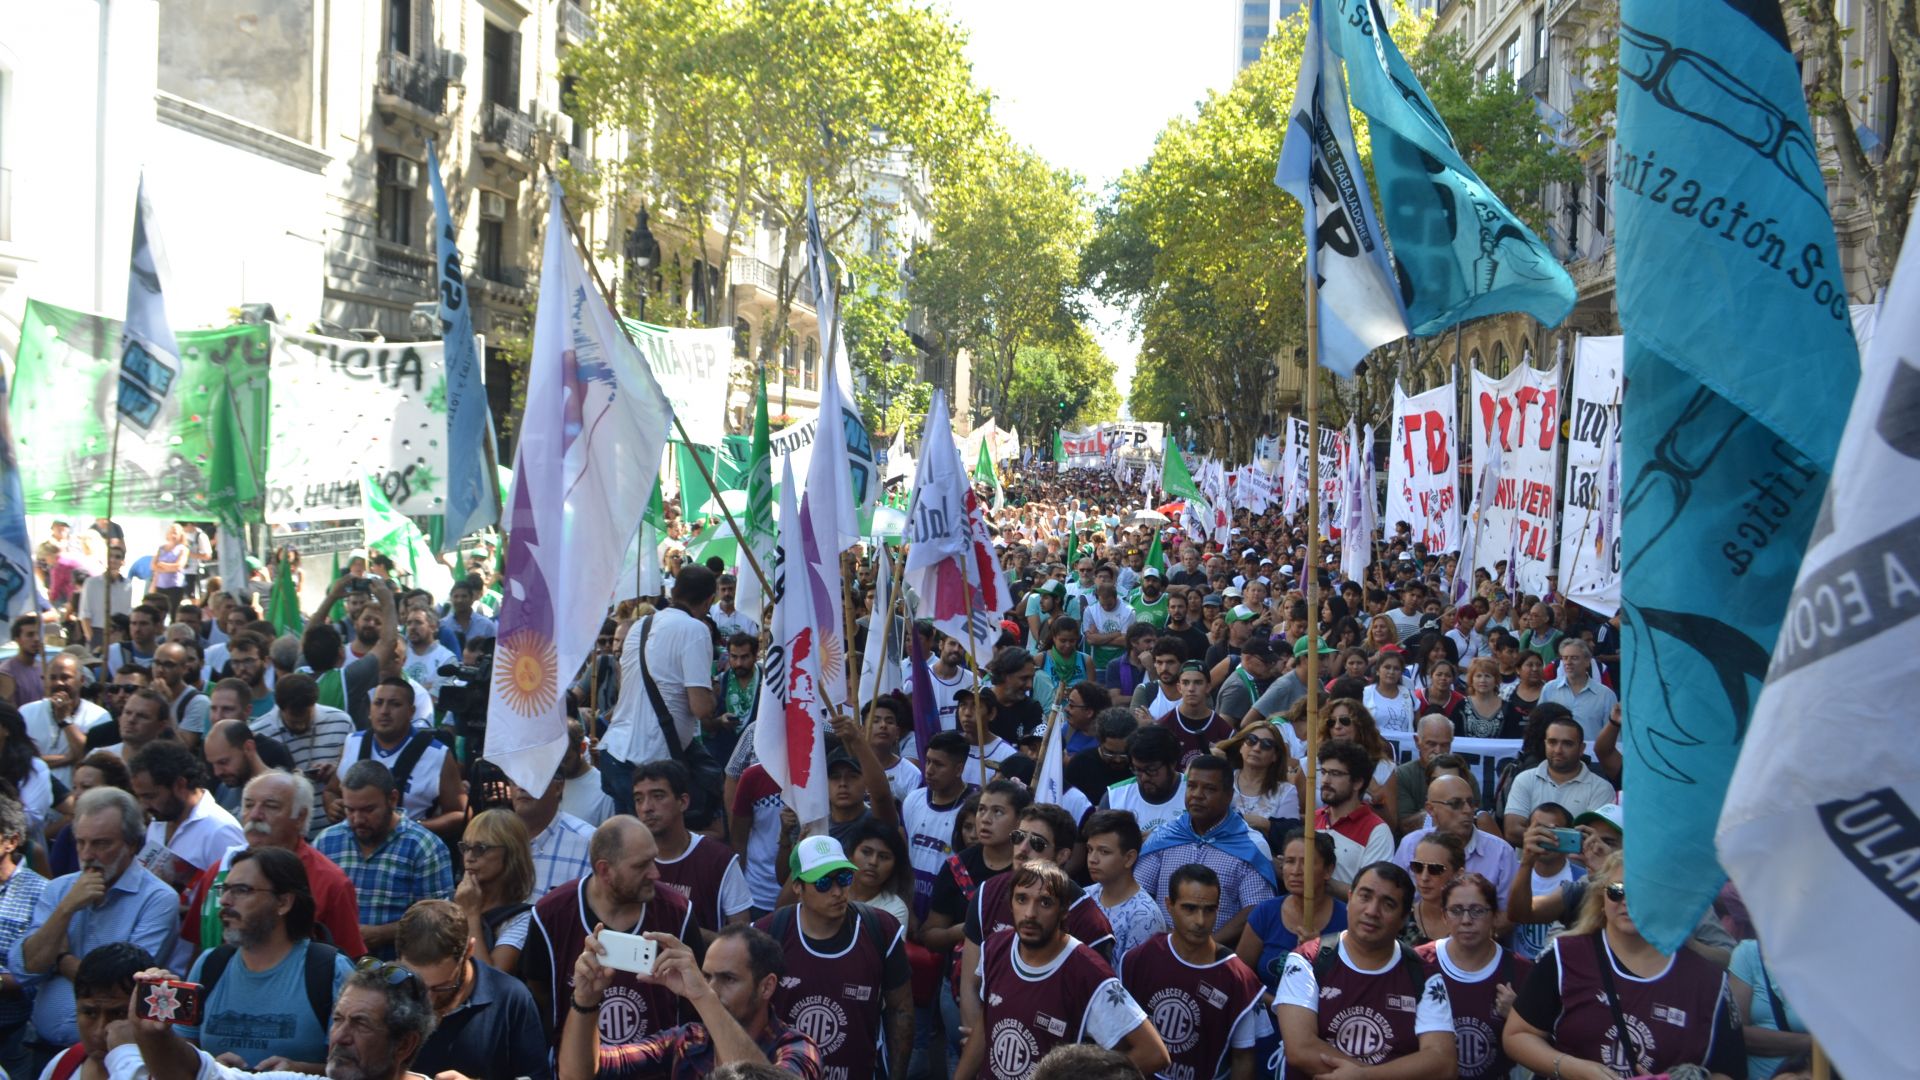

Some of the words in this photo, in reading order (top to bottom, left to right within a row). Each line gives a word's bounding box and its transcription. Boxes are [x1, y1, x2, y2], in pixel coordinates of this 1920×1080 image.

[1324, 140, 1336, 158] DE
[1331, 154, 1372, 250] TRABAJADORES
[600, 1001, 635, 1041] ATE
[799, 1010, 833, 1043] ATE
[1155, 1004, 1189, 1041] ATE
[1327, 1005, 1365, 1034] FORTALECER
[1364, 1007, 1374, 1019] EL
[1373, 1012, 1394, 1039] ESTADO
[1339, 1020, 1379, 1056] ATE
[998, 1034, 1026, 1073] ATE
[1022, 1028, 1040, 1056] ESTADO
